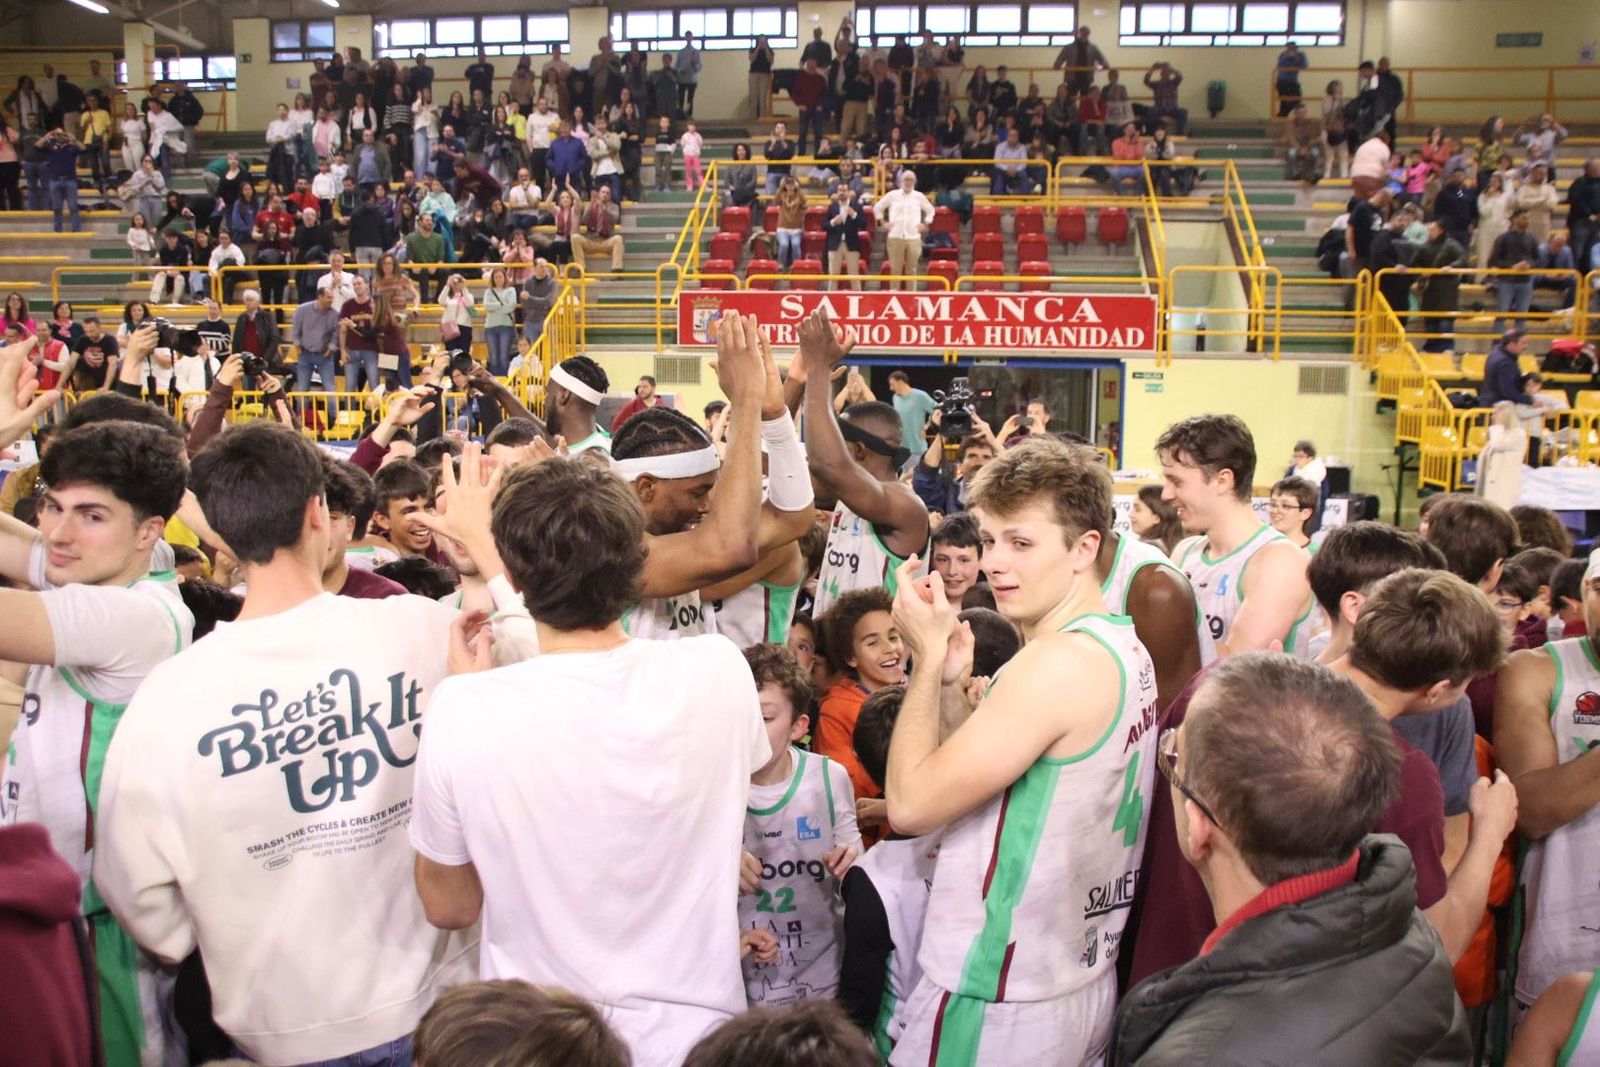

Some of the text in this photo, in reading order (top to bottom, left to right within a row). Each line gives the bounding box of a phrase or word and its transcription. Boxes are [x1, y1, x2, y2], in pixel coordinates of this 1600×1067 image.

[780, 294, 1102, 323] SALAMANCA
[899, 324, 935, 345] DE
[944, 325, 976, 346] LA
[984, 325, 1145, 347] HUMANIDAD
[198, 668, 423, 777] Break It
[231, 682, 337, 731] Let's
[281, 748, 379, 813] Up
[1112, 750, 1144, 847] 4
[247, 837, 285, 854] SMASH
[286, 828, 305, 840] THE
[307, 821, 339, 833] CYCLES
[350, 809, 387, 827] CREATE
[388, 799, 408, 815] NEW
[756, 887, 797, 914] 22
